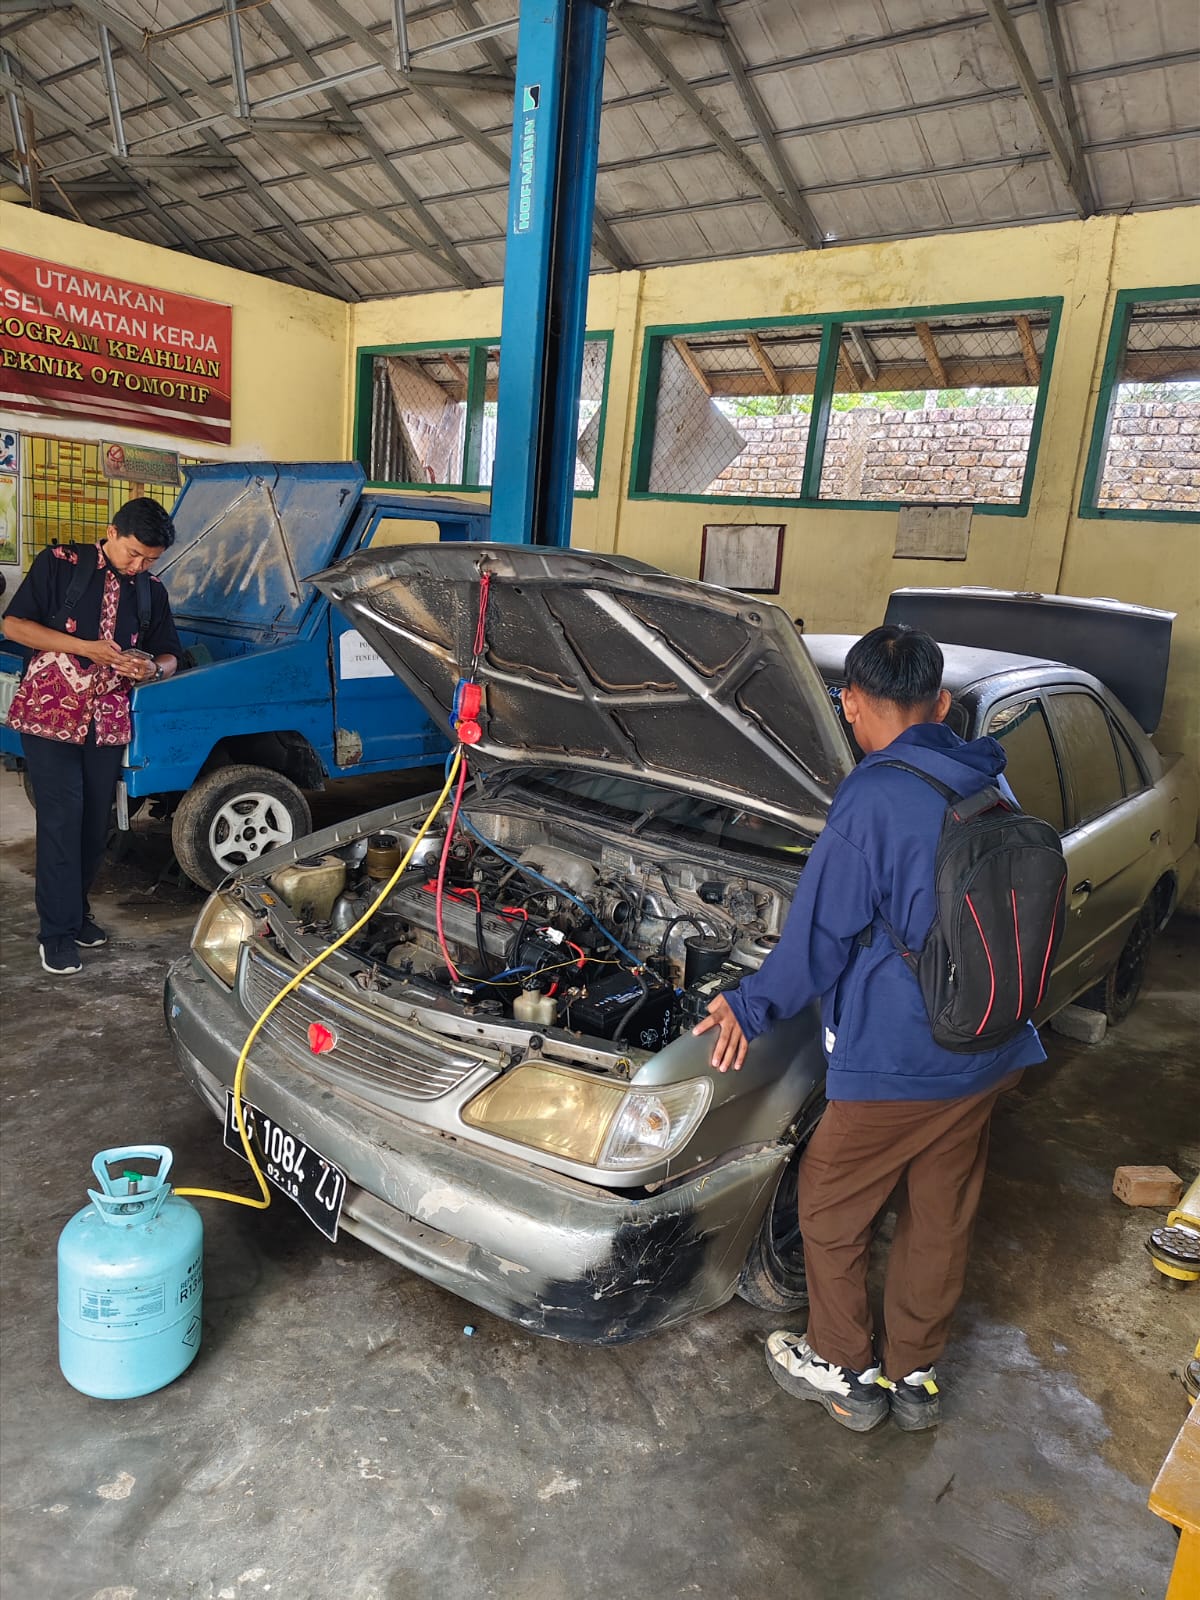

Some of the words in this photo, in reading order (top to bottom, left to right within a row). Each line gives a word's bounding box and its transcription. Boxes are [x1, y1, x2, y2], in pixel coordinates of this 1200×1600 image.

[518, 119, 536, 231] HOFMANN
[0, 287, 147, 339] SELAMATAN
[152, 323, 219, 354] KERJA
[35, 267, 165, 316] UTAMAKAN
[91, 366, 210, 404] OTOMOTIF
[107, 339, 221, 379] KEAHLIAN
[263, 1120, 305, 1182] 1084
[315, 1160, 341, 1211] ZJ
